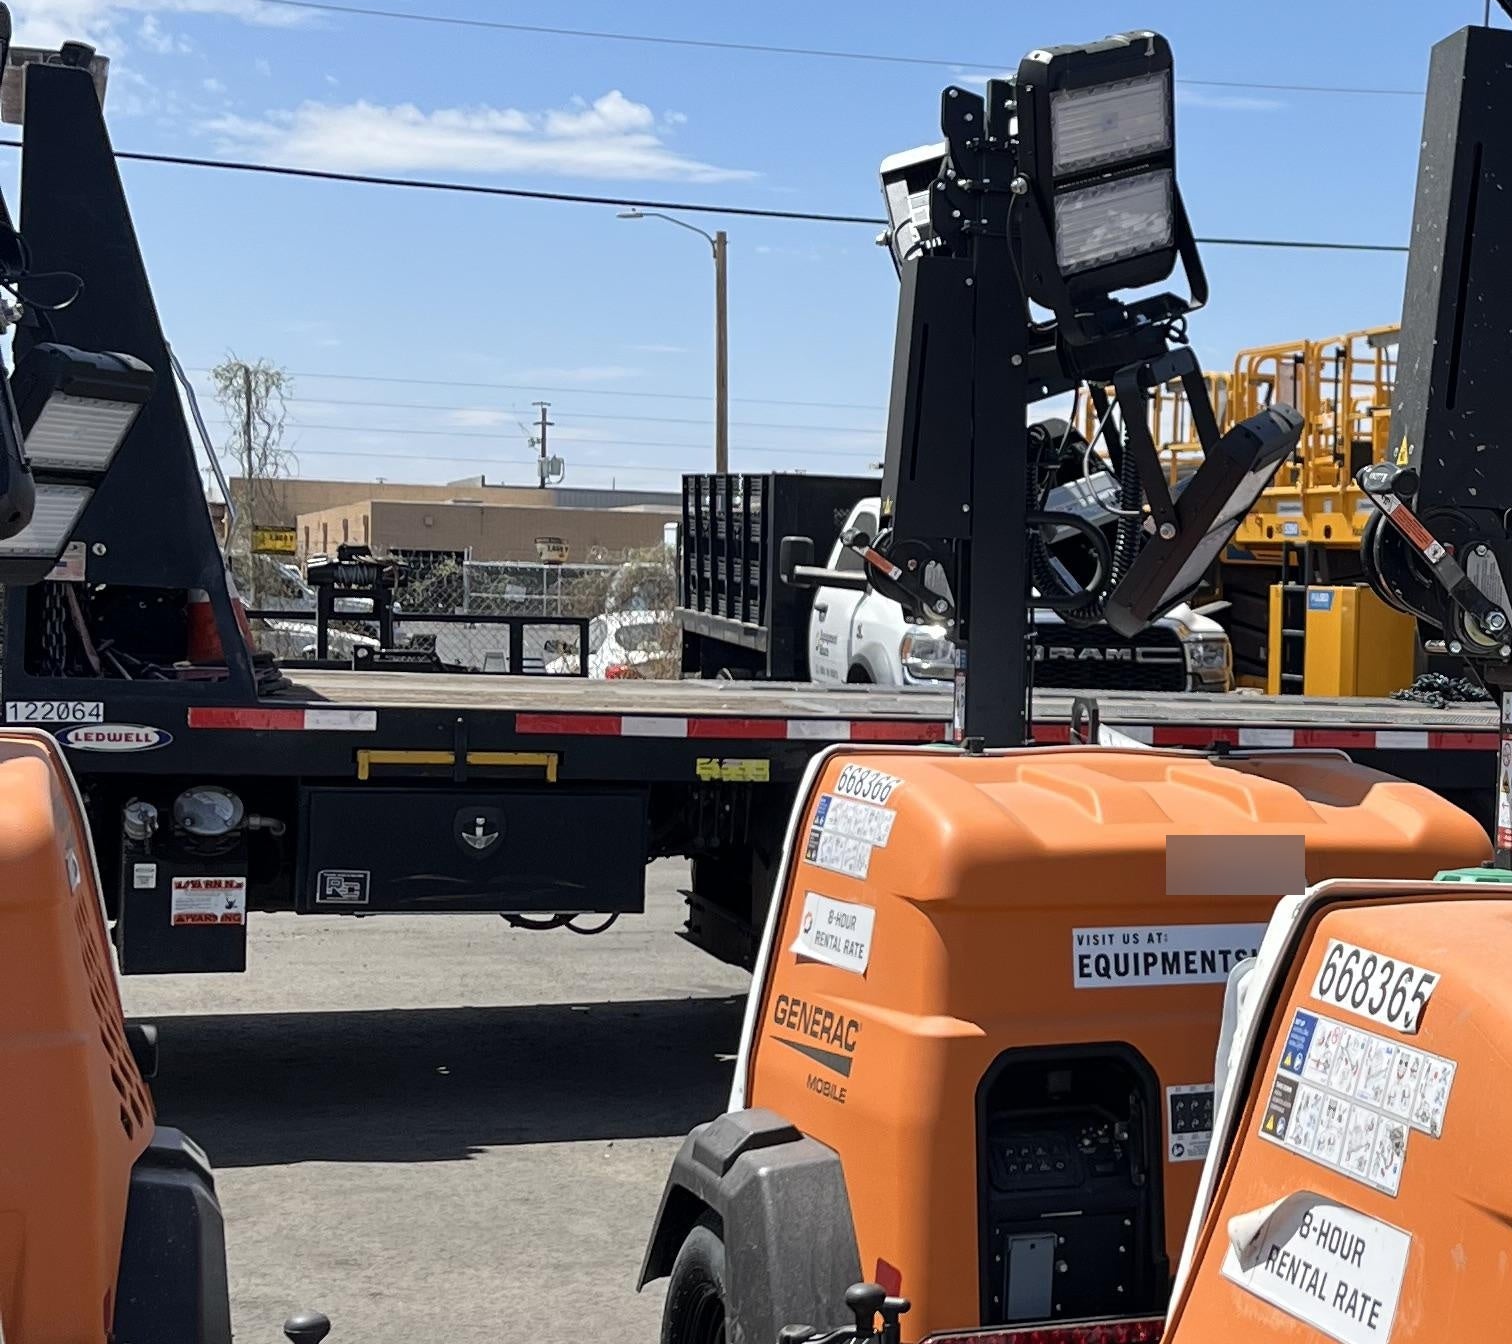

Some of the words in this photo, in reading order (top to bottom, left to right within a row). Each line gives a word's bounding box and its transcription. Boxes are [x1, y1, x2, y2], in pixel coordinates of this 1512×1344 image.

[1049, 647, 1132, 660] RAM
[9, 702, 101, 721] 122064
[74, 732, 153, 743] LEDWELL
[837, 765, 898, 802] 668366
[827, 909, 857, 931] 8-HOUR
[814, 930, 841, 953] RENTAL
[843, 941, 865, 959] RATE
[1077, 934, 1114, 945] VISIT
[1122, 933, 1139, 944] US
[1147, 932, 1168, 944] AT:
[1078, 949, 1258, 979] EQUIPMENT
[1319, 943, 1434, 1028] 668365
[774, 994, 859, 1053] GENERAC
[806, 1074, 847, 1104] MOBILE
[1299, 1212, 1366, 1268] 8-HOUR
[1263, 1243, 1327, 1303] RENTAL
[1332, 1279, 1384, 1331] RATE
